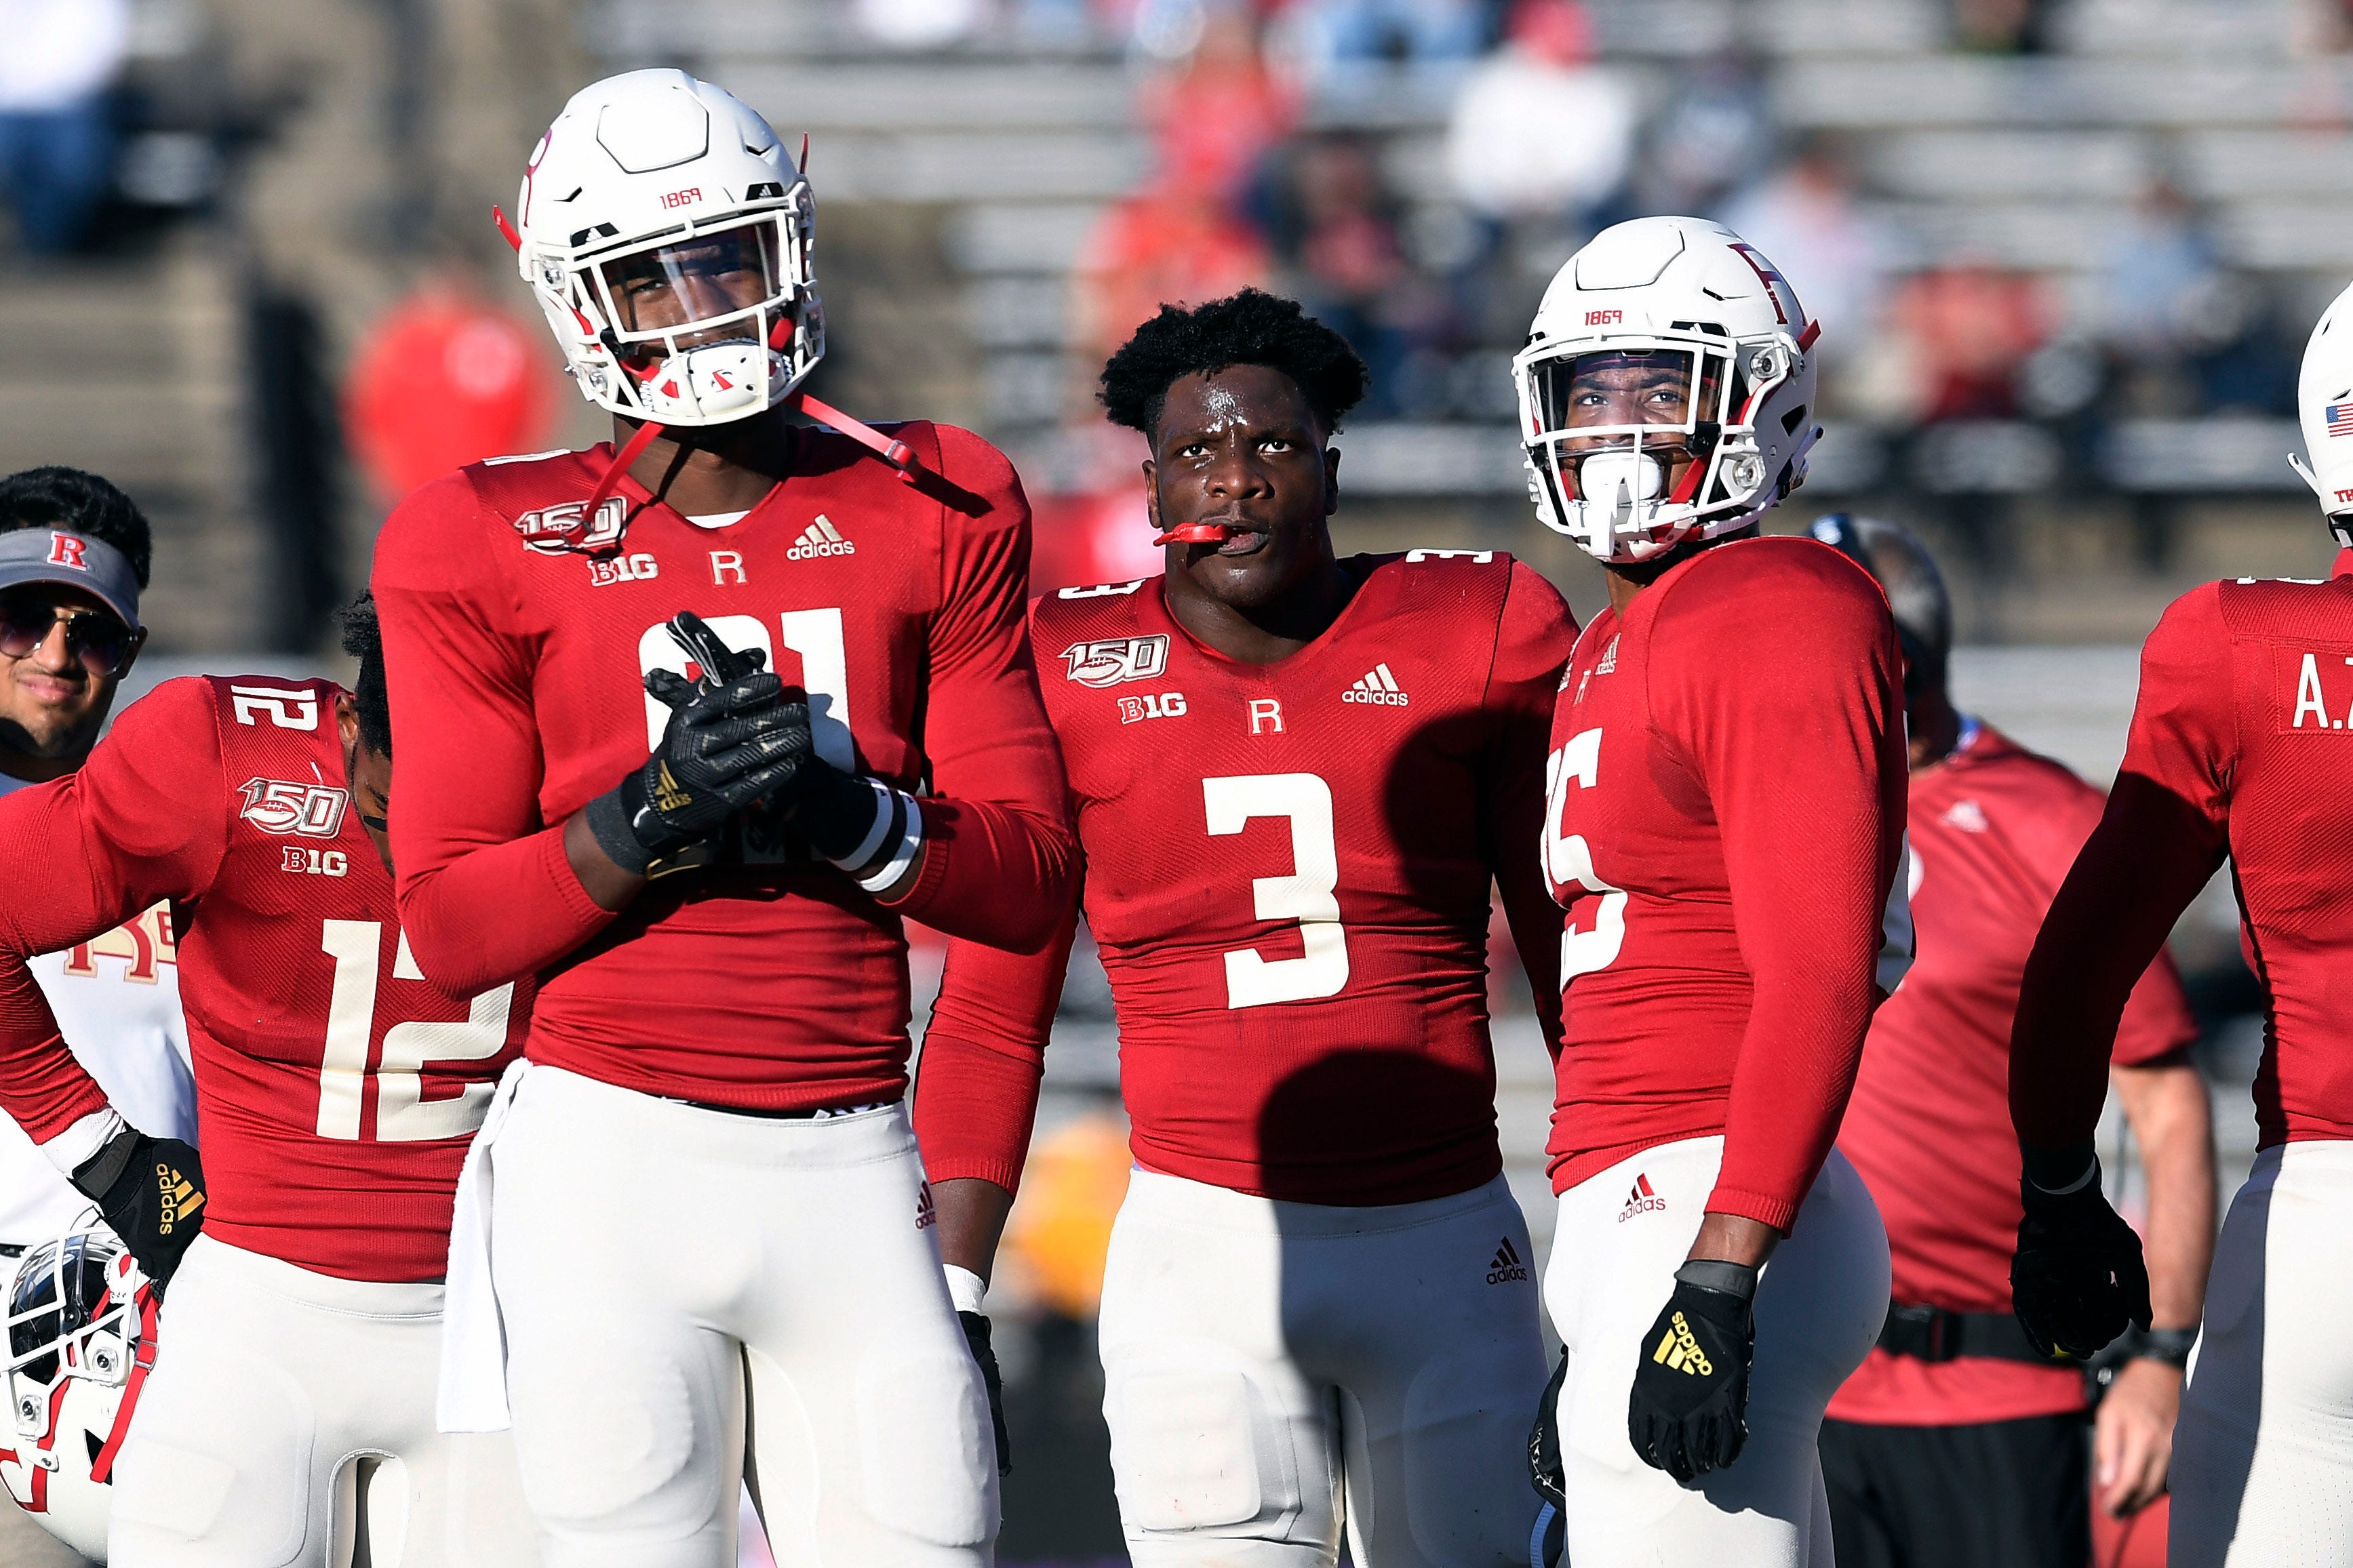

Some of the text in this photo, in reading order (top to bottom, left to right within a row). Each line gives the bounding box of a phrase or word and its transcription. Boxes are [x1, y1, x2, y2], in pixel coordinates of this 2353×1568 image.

[660, 188, 702, 209] 1869
[1585, 310, 1623, 325] 1869
[47, 531, 87, 571] R
[709, 550, 747, 585] R
[786, 540, 856, 561] adidas
[1058, 633, 1170, 689] 150
[231, 685, 319, 732] 12
[1341, 687, 1409, 707] adidas
[2292, 653, 2353, 730] A.
[1248, 699, 1283, 734] R
[237, 776, 349, 839] 150
[1540, 727, 1628, 994] 5
[1202, 773, 1350, 1010] 3
[156, 1163, 178, 1235] adidas
[1618, 1197, 1666, 1223] adidas
[1486, 1264, 1527, 1285] adidas
[1672, 1311, 1713, 1376] adidas
